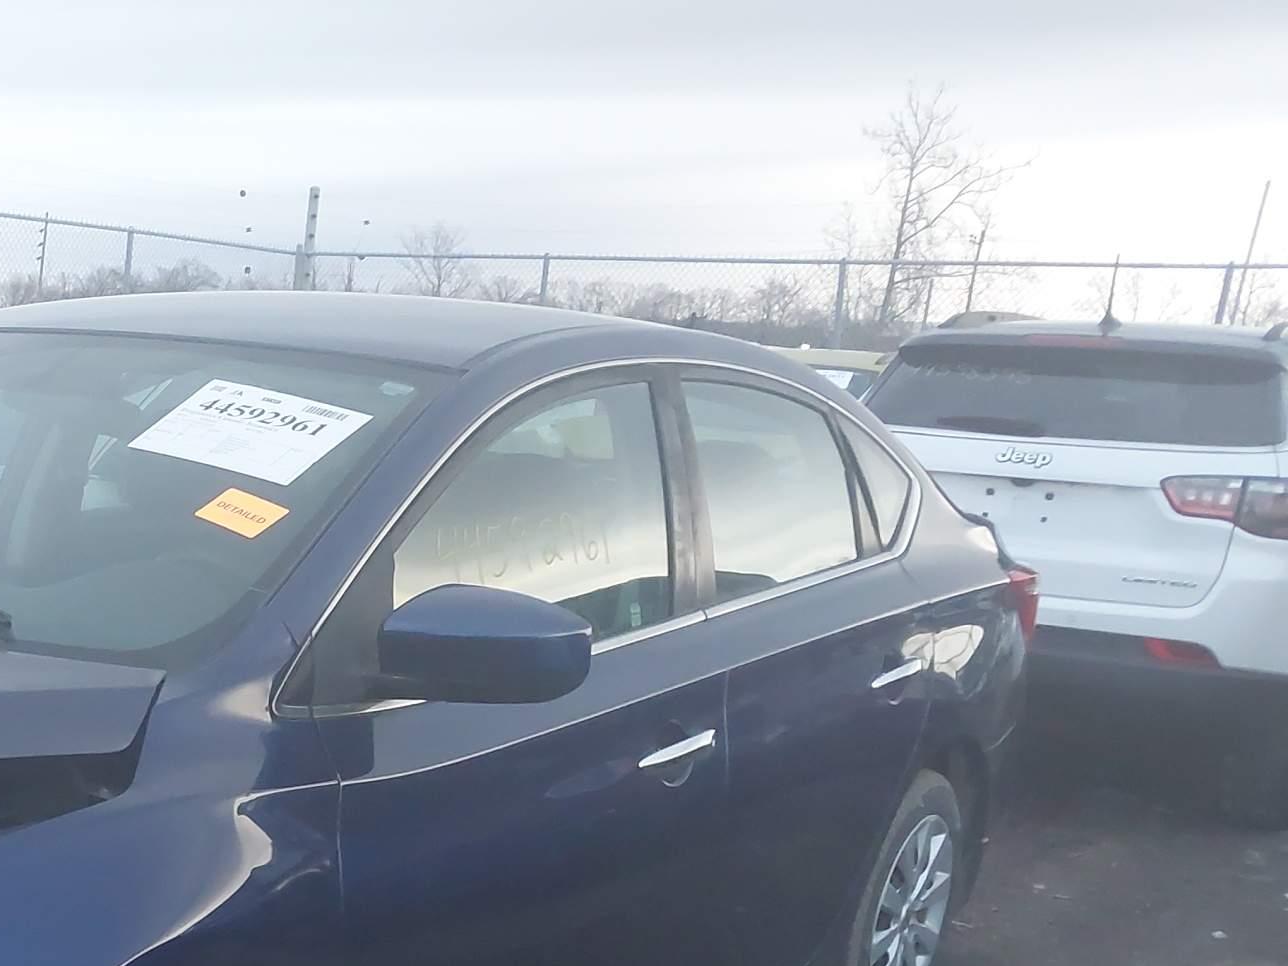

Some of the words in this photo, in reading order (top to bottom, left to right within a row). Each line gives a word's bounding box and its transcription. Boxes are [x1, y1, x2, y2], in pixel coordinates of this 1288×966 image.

[199, 398, 329, 437] 44592961
[995, 447, 1053, 468] Jeep
[216, 499, 267, 525] DETAILED
